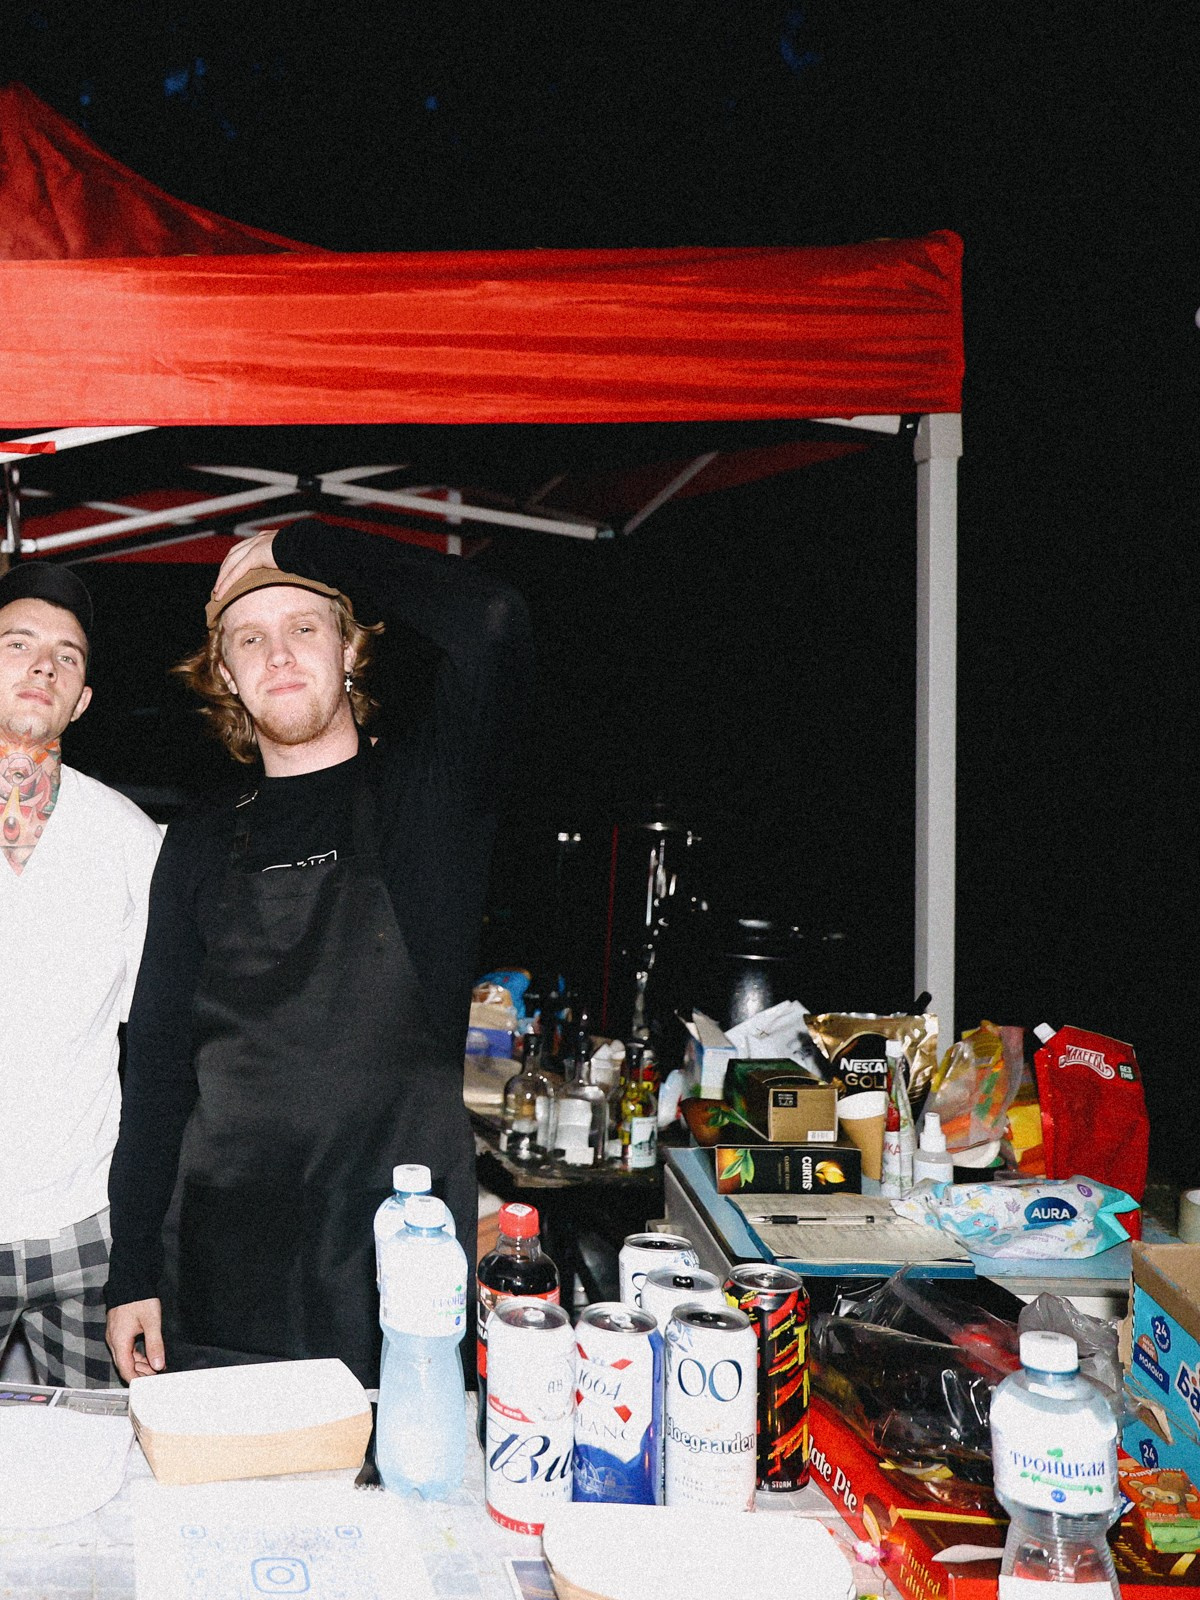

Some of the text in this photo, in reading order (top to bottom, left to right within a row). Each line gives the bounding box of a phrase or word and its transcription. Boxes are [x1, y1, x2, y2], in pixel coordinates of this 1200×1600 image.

[802, 1155, 813, 1191] CURTIS
[1031, 1207, 1071, 1220] AURA
[1154, 1321, 1167, 1337] 24
[1143, 1444, 1155, 1461] 24
[771, 1480, 793, 1489] STORM
[832, 1465, 859, 1515] Pie
[901, 1541, 941, 1596] Limited
